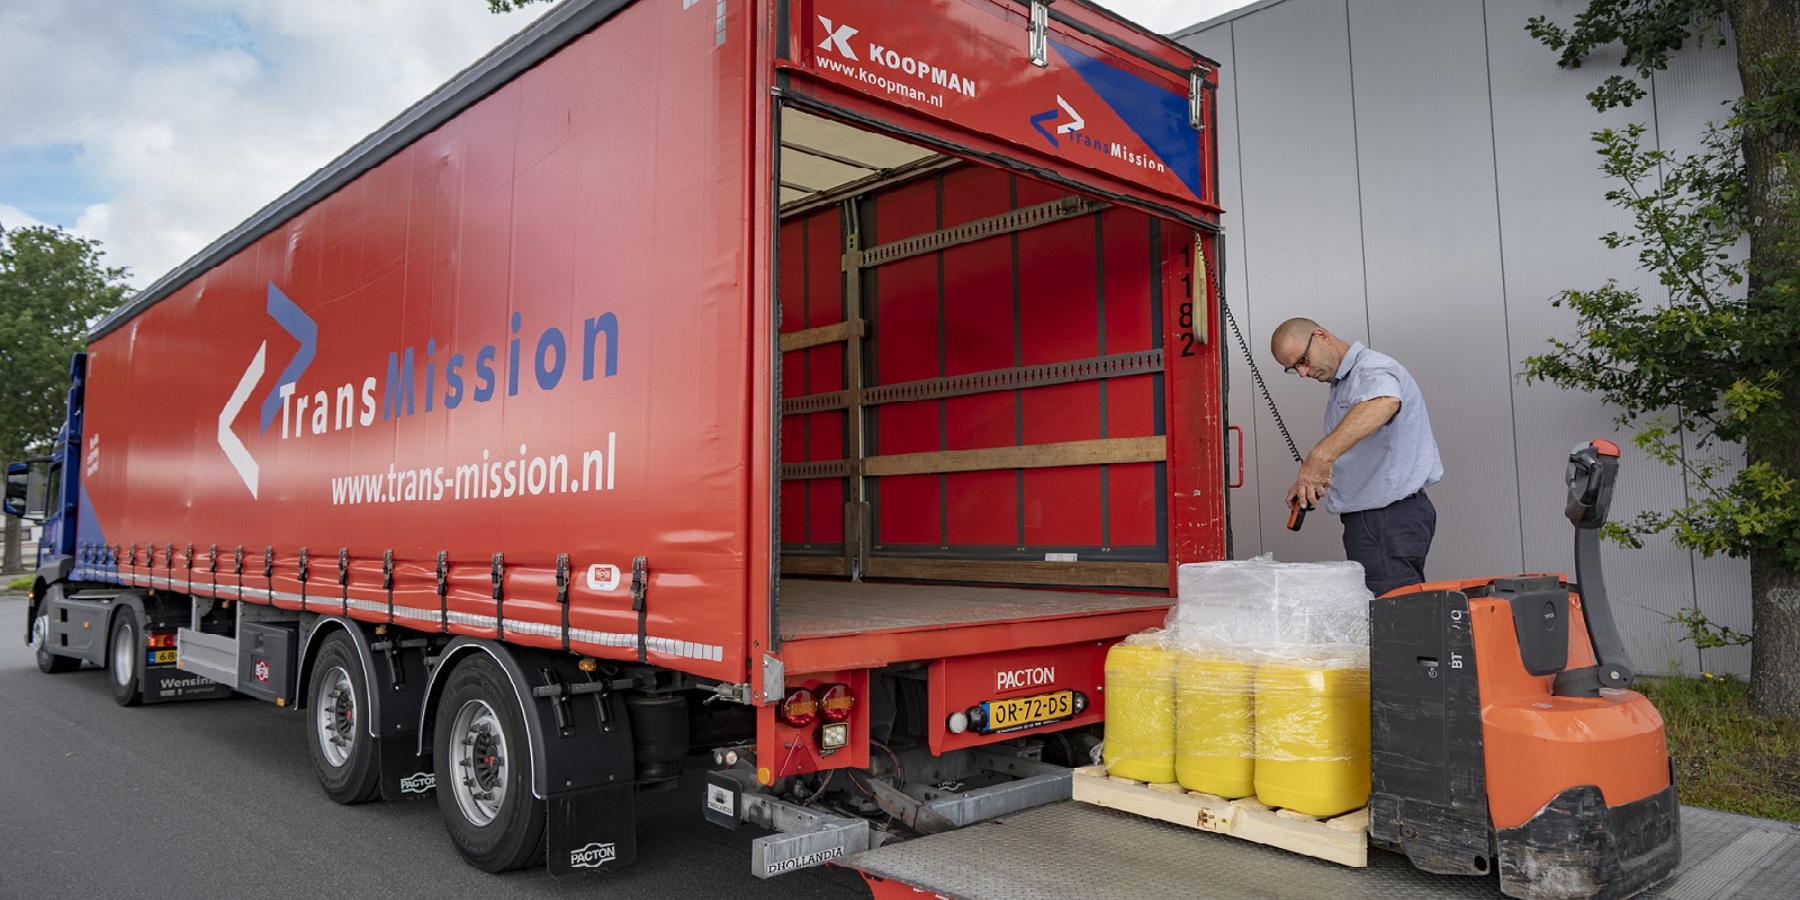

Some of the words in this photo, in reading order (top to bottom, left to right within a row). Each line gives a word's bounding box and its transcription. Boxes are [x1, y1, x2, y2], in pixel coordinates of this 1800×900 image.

[816, 55, 943, 108] www.koopman.nl
[869, 43, 976, 98] KOOPMAN
[1067, 126, 1165, 173] TransMission
[278, 311, 619, 440] TransMission
[331, 431, 616, 505] www.trans-mission.nl
[997, 666, 1055, 690] PACTON
[1451, 652, 1463, 669] BT
[996, 695, 1068, 724] OR-72-DS
[571, 846, 615, 865] PACTON
[768, 847, 843, 874] DHOLLANDIA
